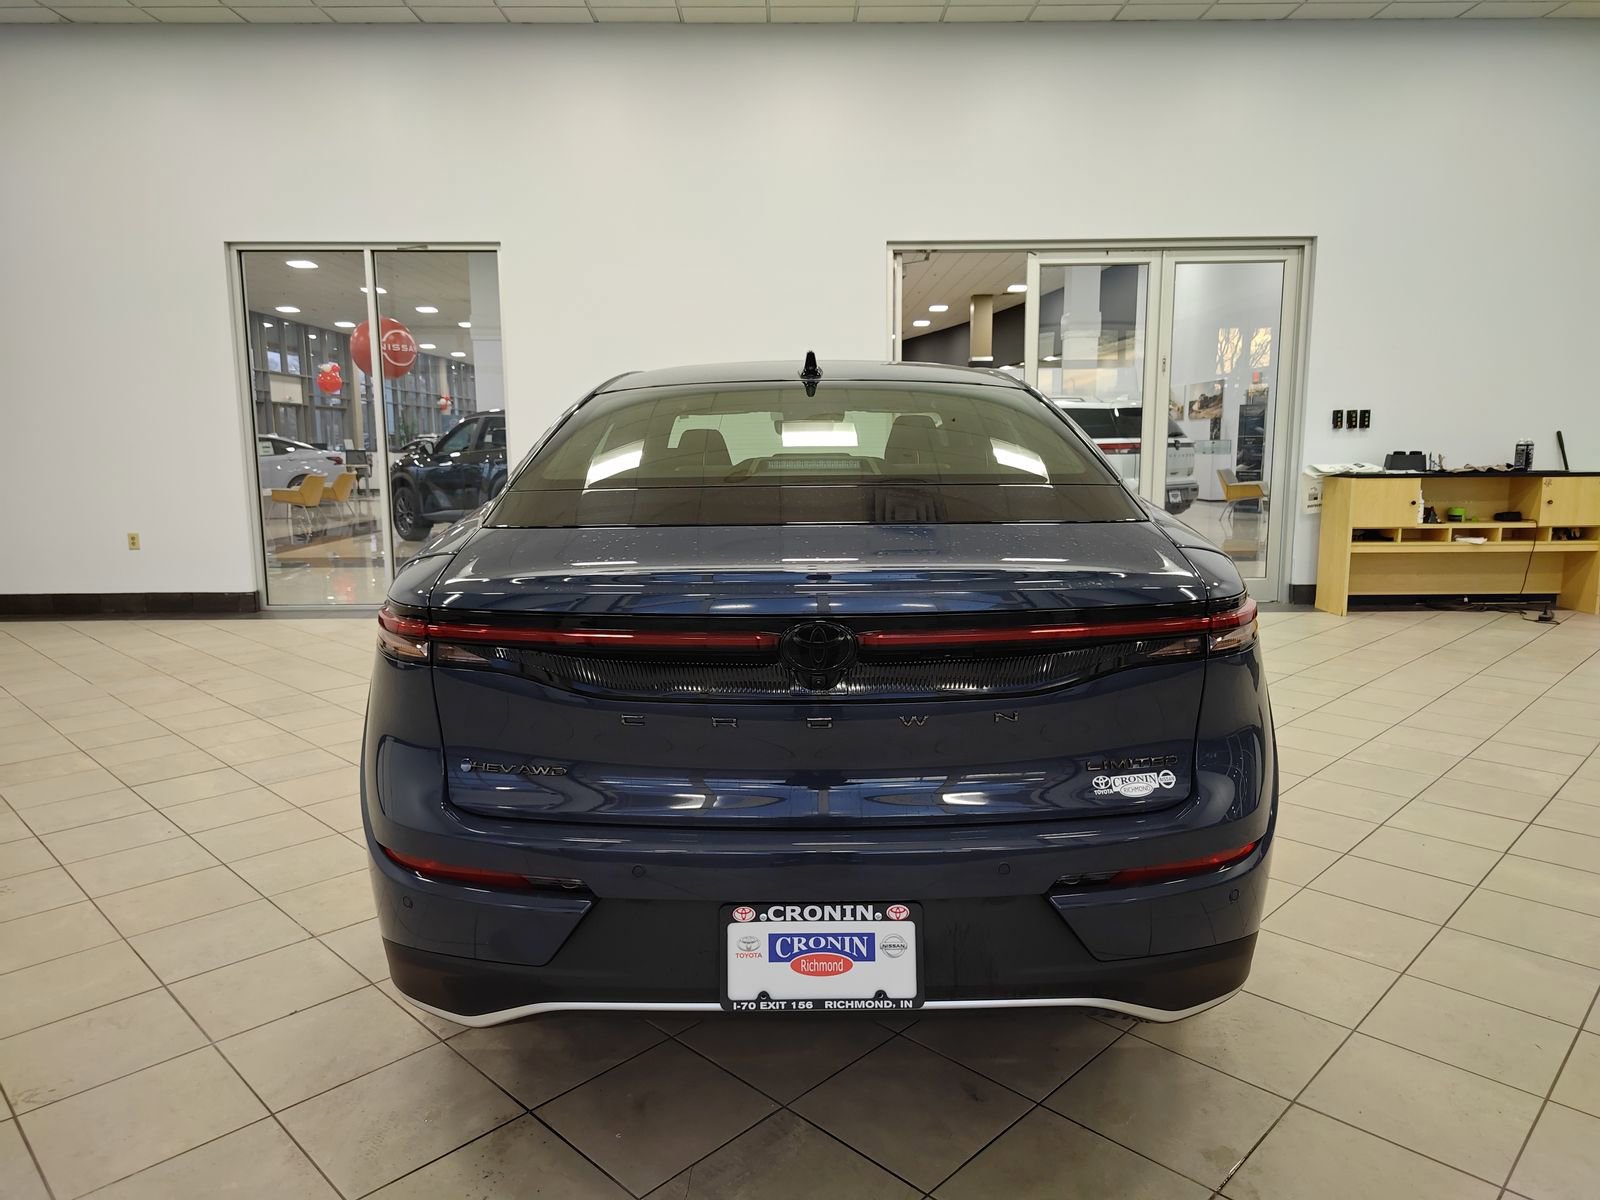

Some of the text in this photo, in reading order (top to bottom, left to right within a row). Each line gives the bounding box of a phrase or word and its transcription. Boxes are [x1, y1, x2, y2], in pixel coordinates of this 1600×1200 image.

[621, 710, 1019, 729] CROWN
[472, 761, 568, 776] HEV AWD
[1086, 755, 1178, 771] LIMITED
[1112, 773, 1157, 787] CRONIN
[1094, 788, 1114, 796] TOYOTA
[767, 905, 874, 921] CRONIN
[775, 936, 869, 958] CRONIN
[800, 959, 844, 972] Richmond
[733, 1001, 757, 1010] I-70
[759, 1001, 787, 1010] EXIT
[791, 1001, 814, 1009] 156
[900, 1000, 913, 1009] IN
